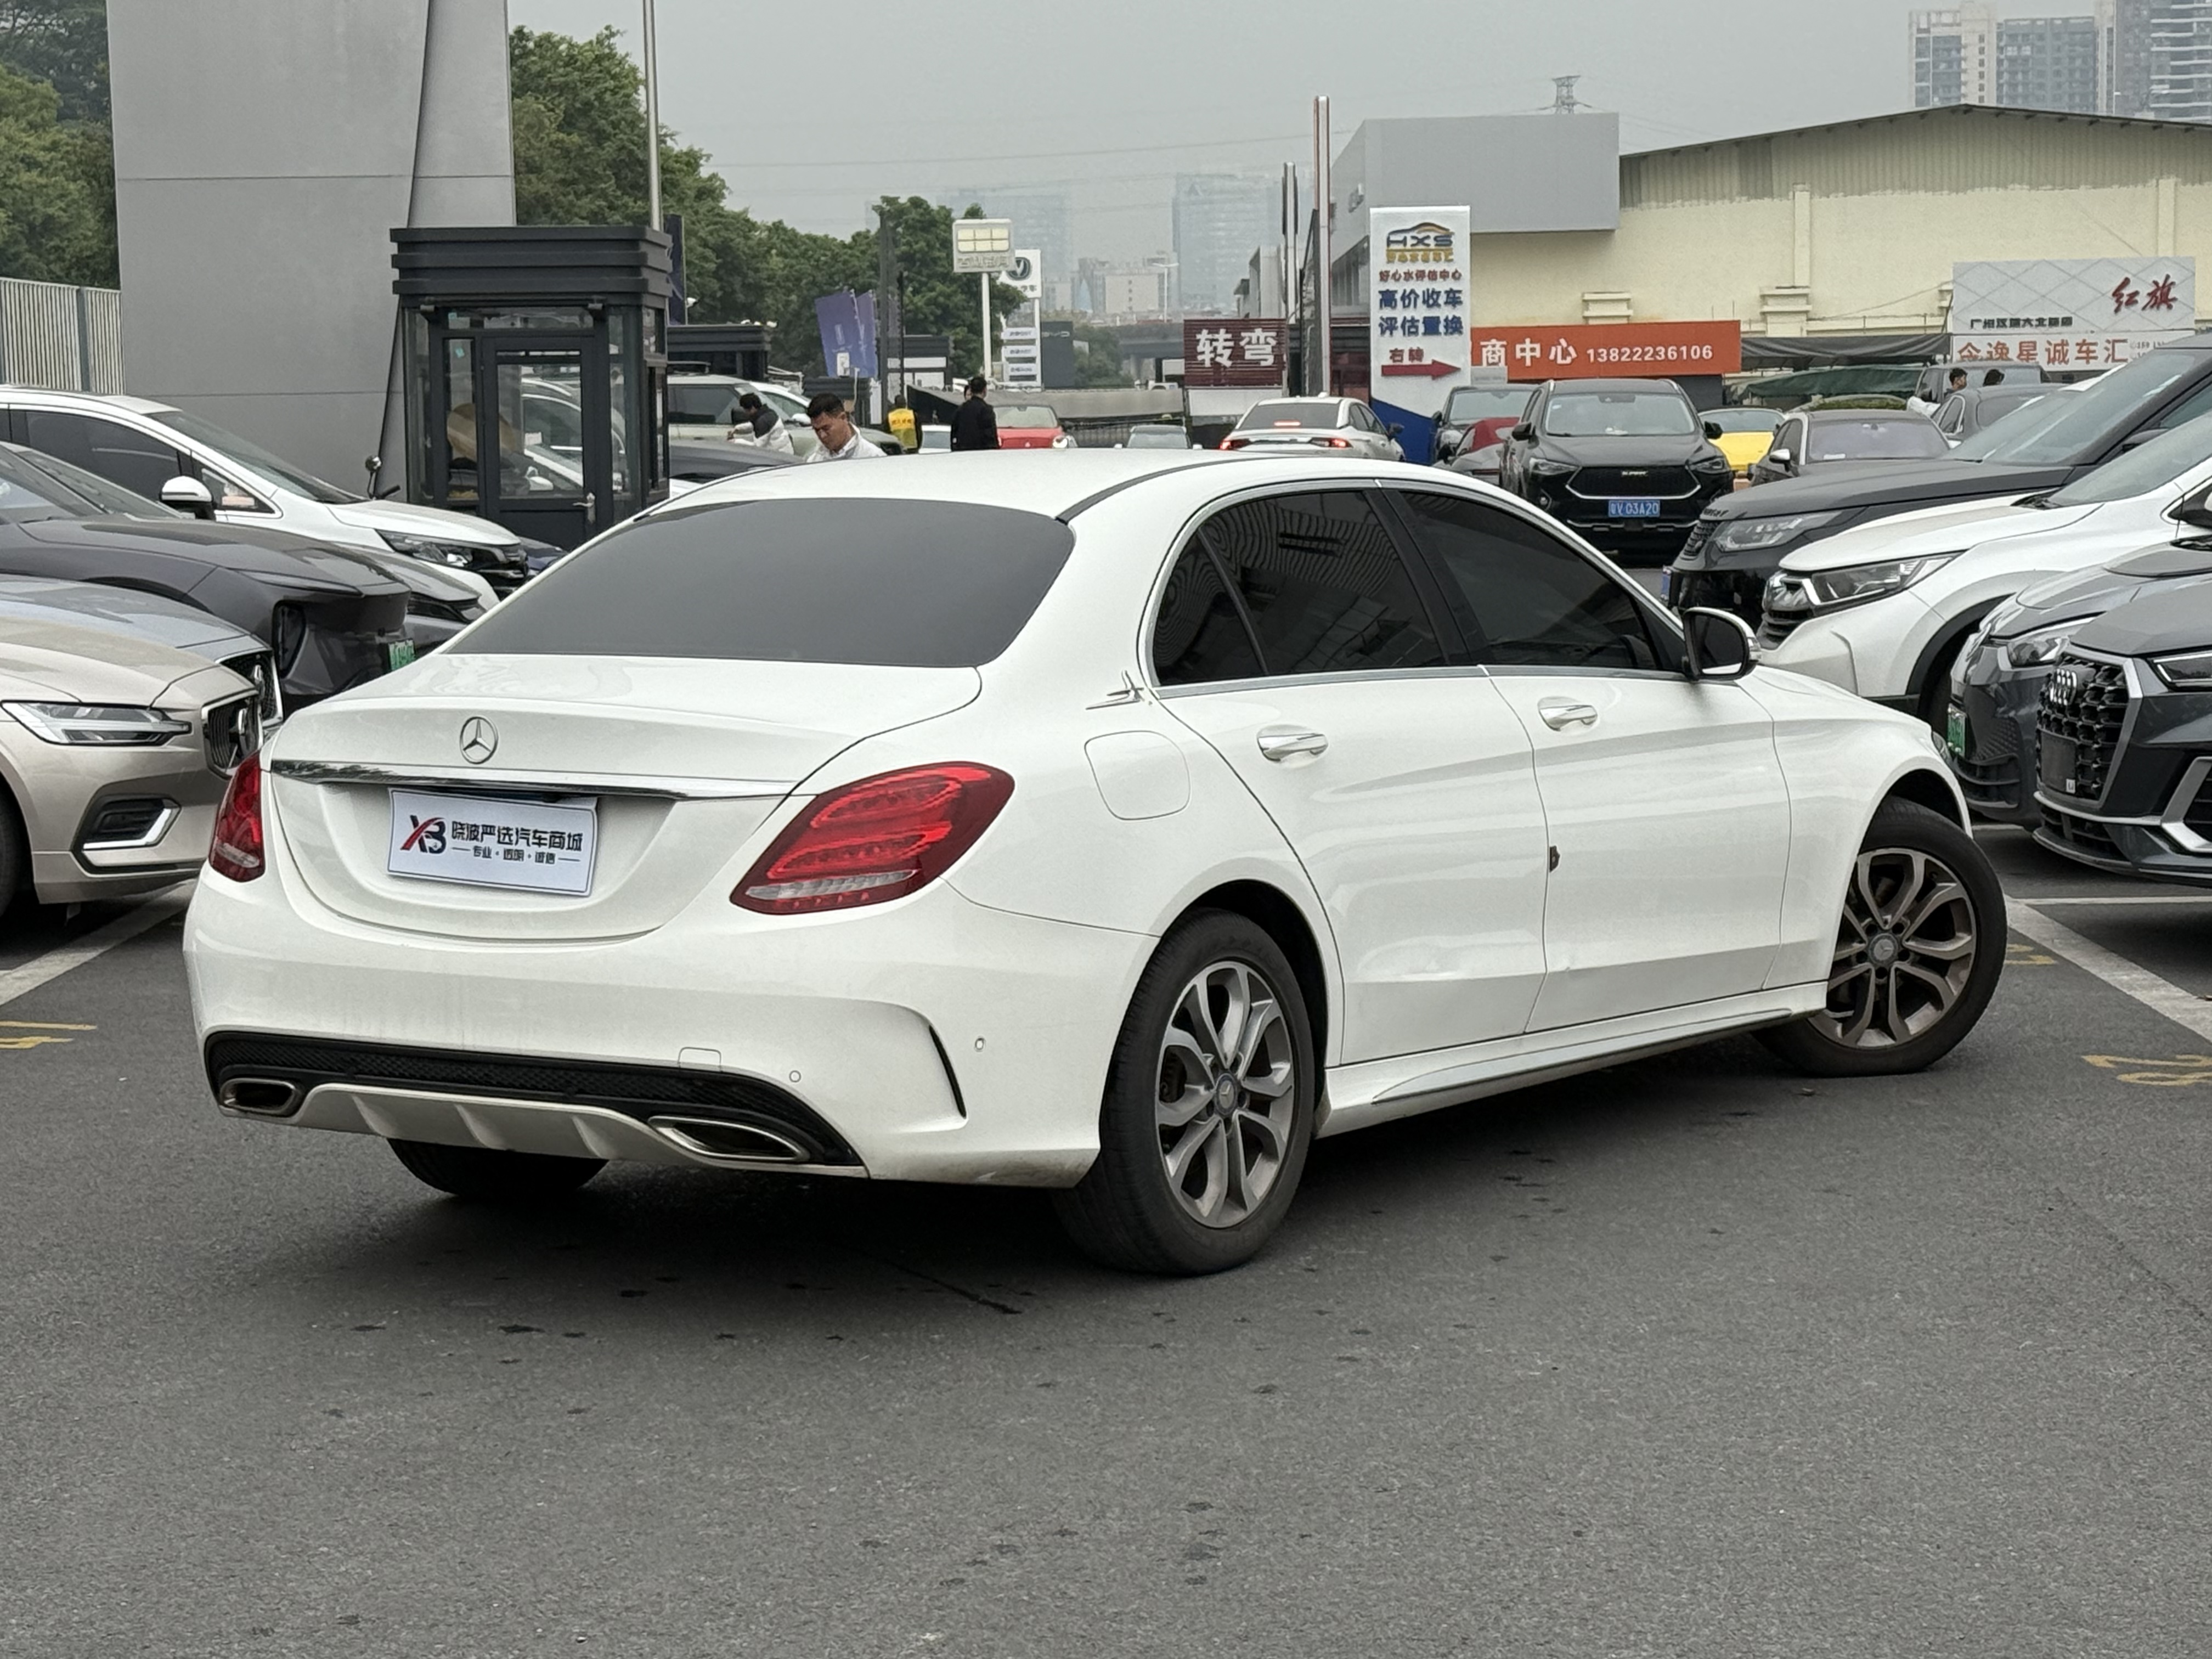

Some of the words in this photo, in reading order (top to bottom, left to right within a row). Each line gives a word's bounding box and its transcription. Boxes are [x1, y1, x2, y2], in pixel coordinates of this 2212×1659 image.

[1386, 235, 1453, 247] HXS
[1378, 288, 1463, 310] 高价收车
[2112, 273, 2179, 314] 红旗
[1378, 314, 1463, 337] 评估置换
[1195, 328, 1278, 368] 转弯
[1587, 344, 1713, 363] 13822236106
